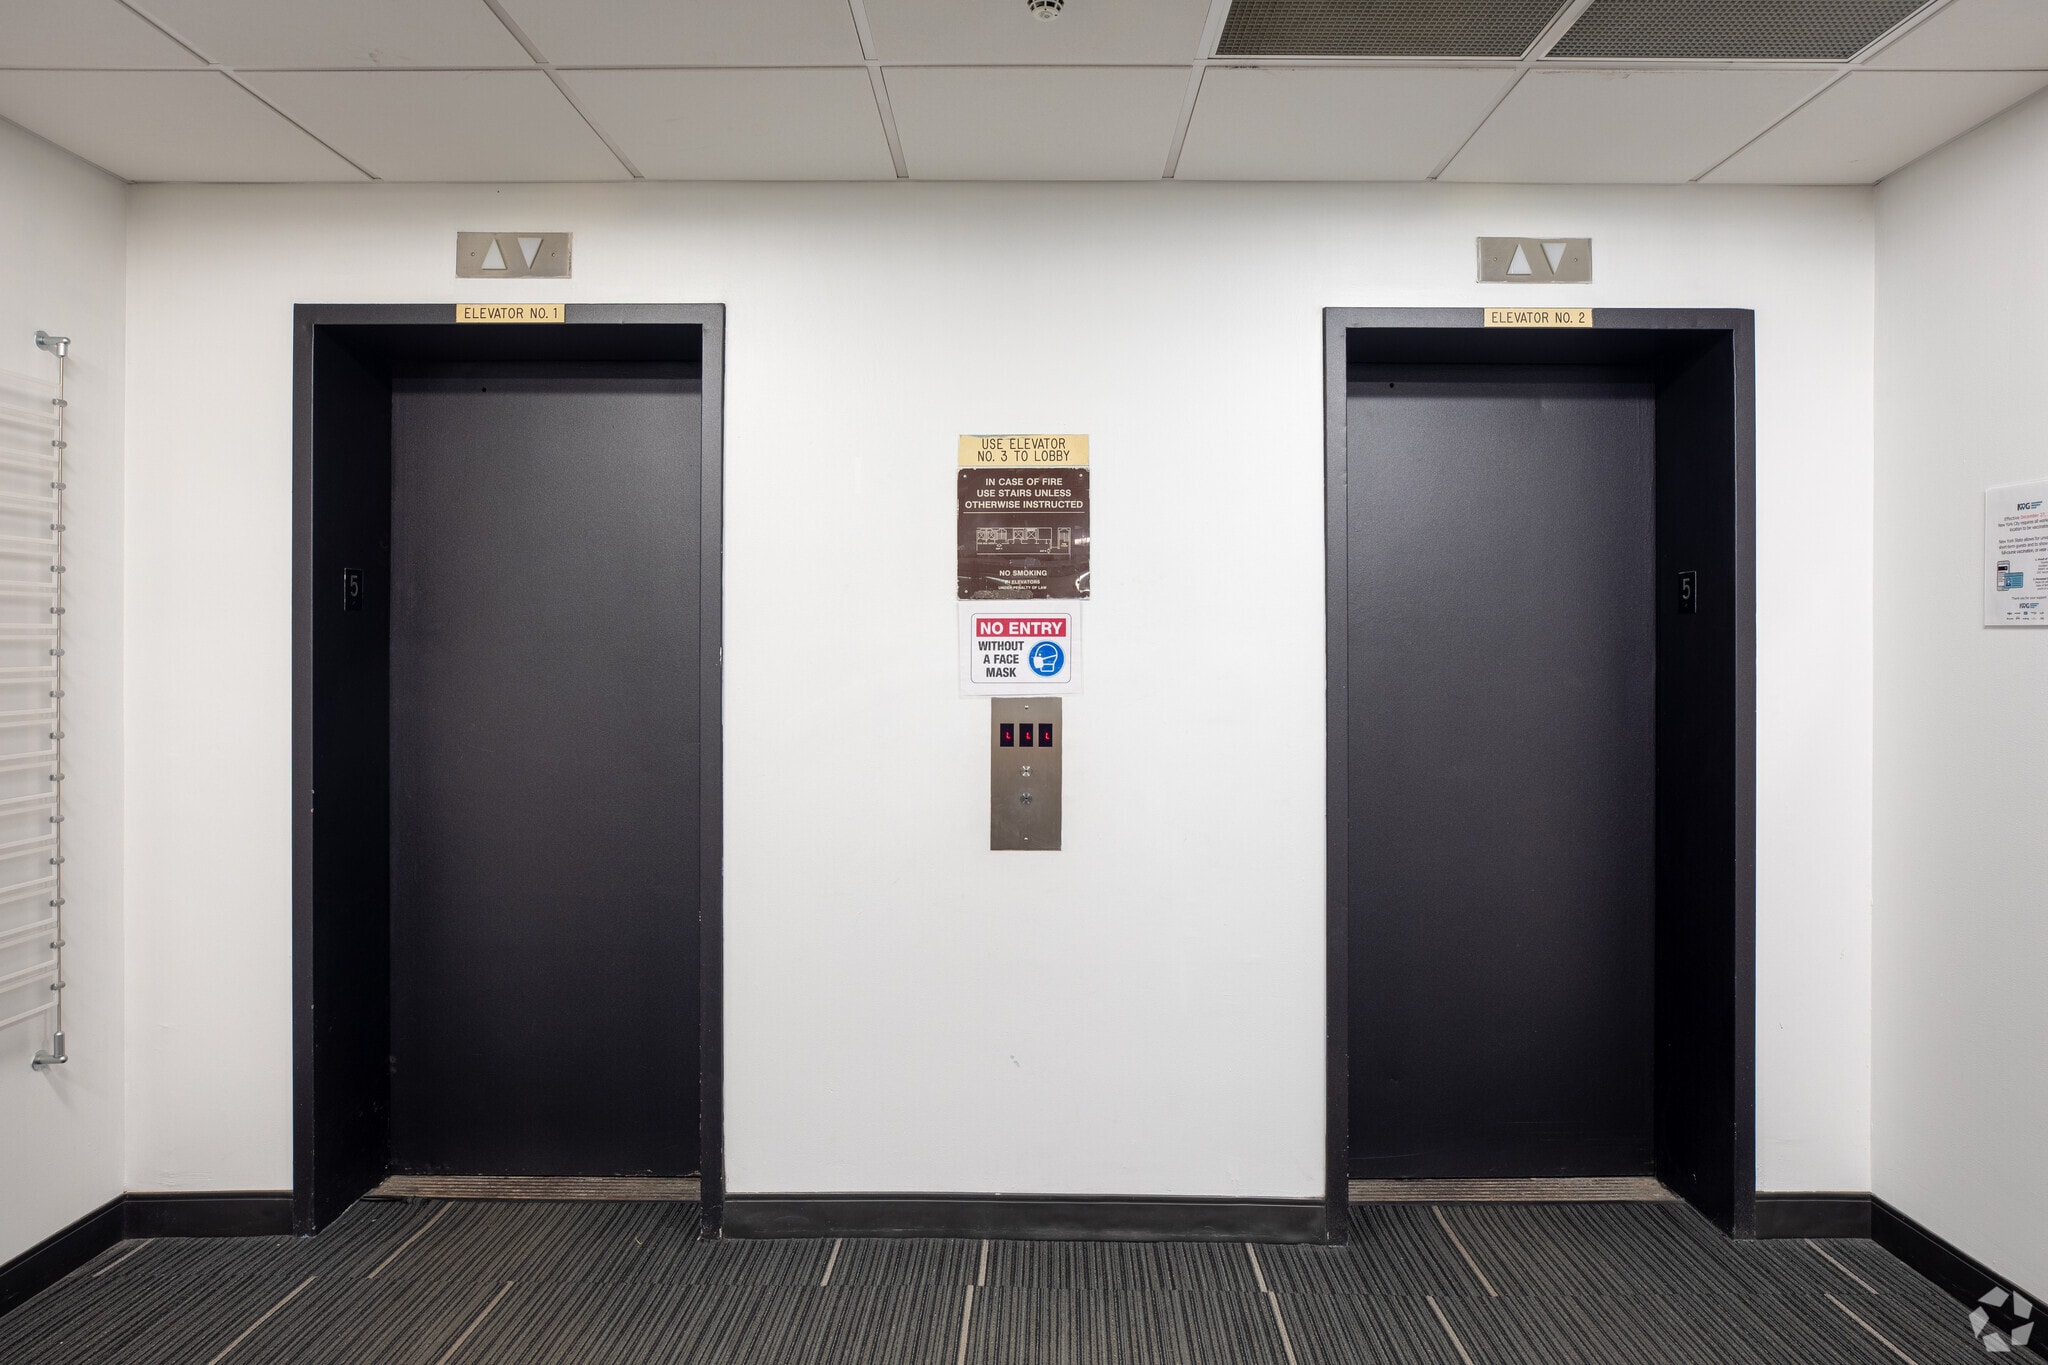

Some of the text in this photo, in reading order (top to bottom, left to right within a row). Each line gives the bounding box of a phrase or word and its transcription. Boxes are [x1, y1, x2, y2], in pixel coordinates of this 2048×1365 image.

[464, 307, 558, 319] ELEVATOR NO. 1
[1491, 312, 1585, 324] ELEVATOR NO. 2
[981, 437, 1066, 450] USE ELEVATOR
[977, 450, 1070, 462] NO. 3 TO LOBBY
[985, 477, 1063, 486] IN CASE OF FIRE
[976, 489, 1072, 498] USE STAIRS UNLESS
[964, 500, 1084, 509] OTHERWISE INSTRUCTED
[999, 569, 1048, 577] NO SMOKING
[350, 574, 359, 597] 5
[1682, 577, 1691, 600] 5
[980, 621, 1063, 635] NO ENTRY
[978, 640, 1025, 651] WITHOUT
[983, 654, 1019, 664] A FACE
[986, 667, 1017, 678] MASK
